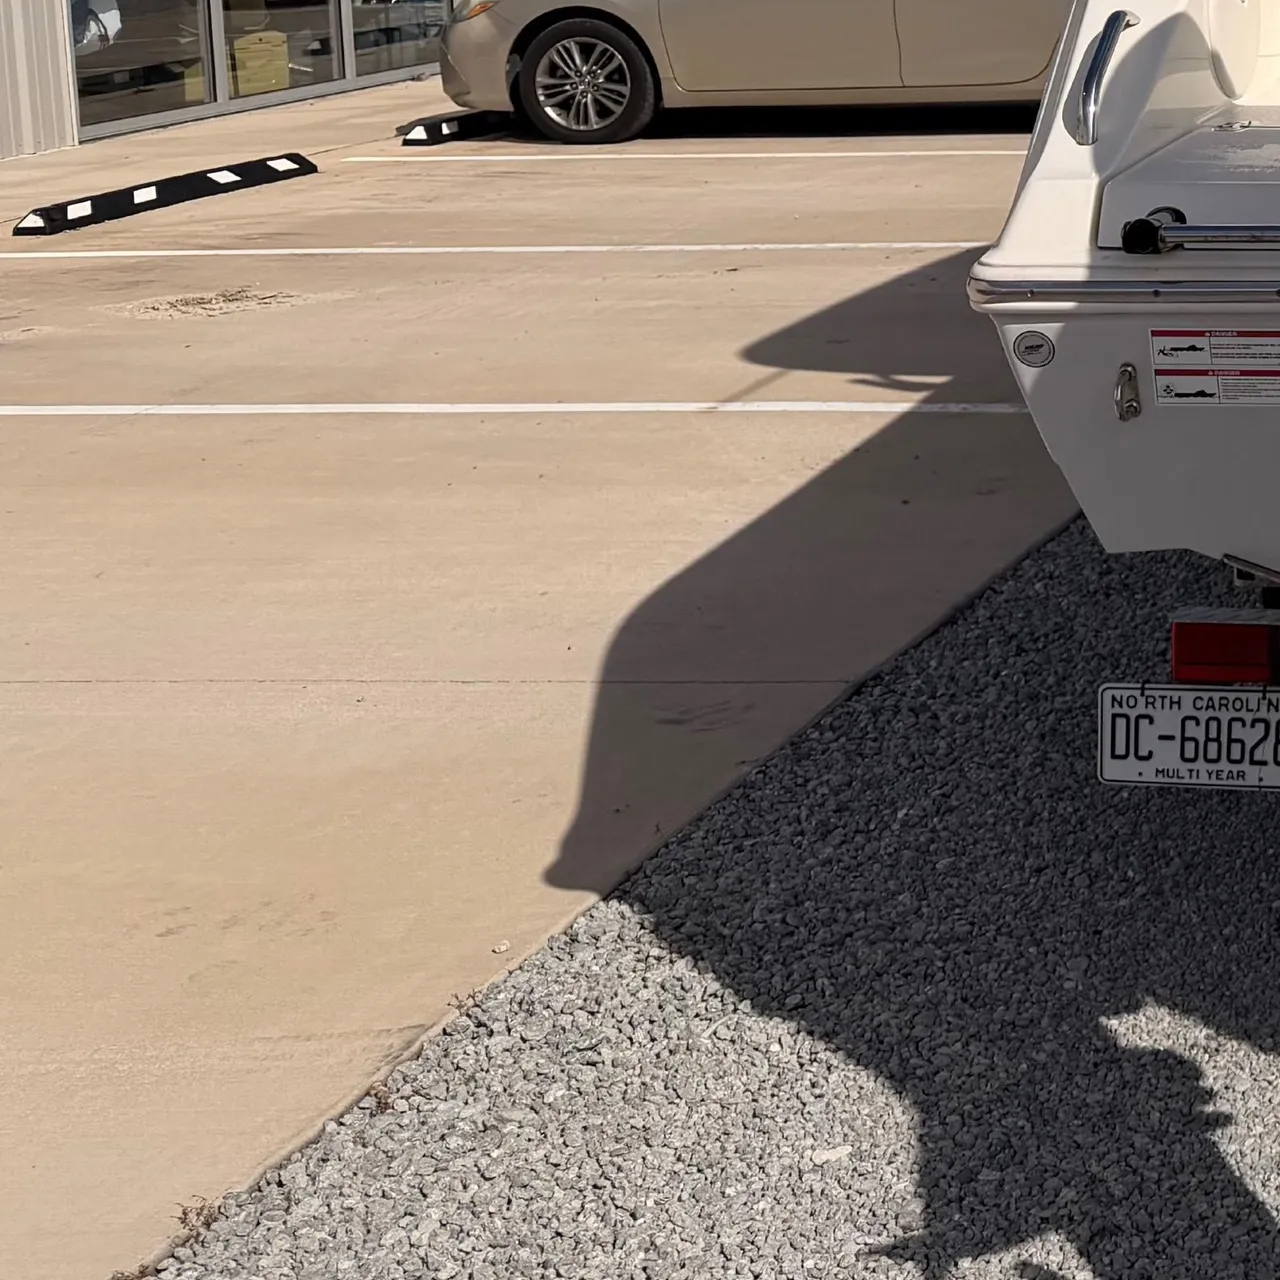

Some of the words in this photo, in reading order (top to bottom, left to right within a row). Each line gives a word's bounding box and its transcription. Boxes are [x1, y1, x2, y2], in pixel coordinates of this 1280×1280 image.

[1111, 694, 1182, 712] NORTH
[1155, 768, 1200, 780] MULTI
[1206, 770, 1246, 782] YEAR
